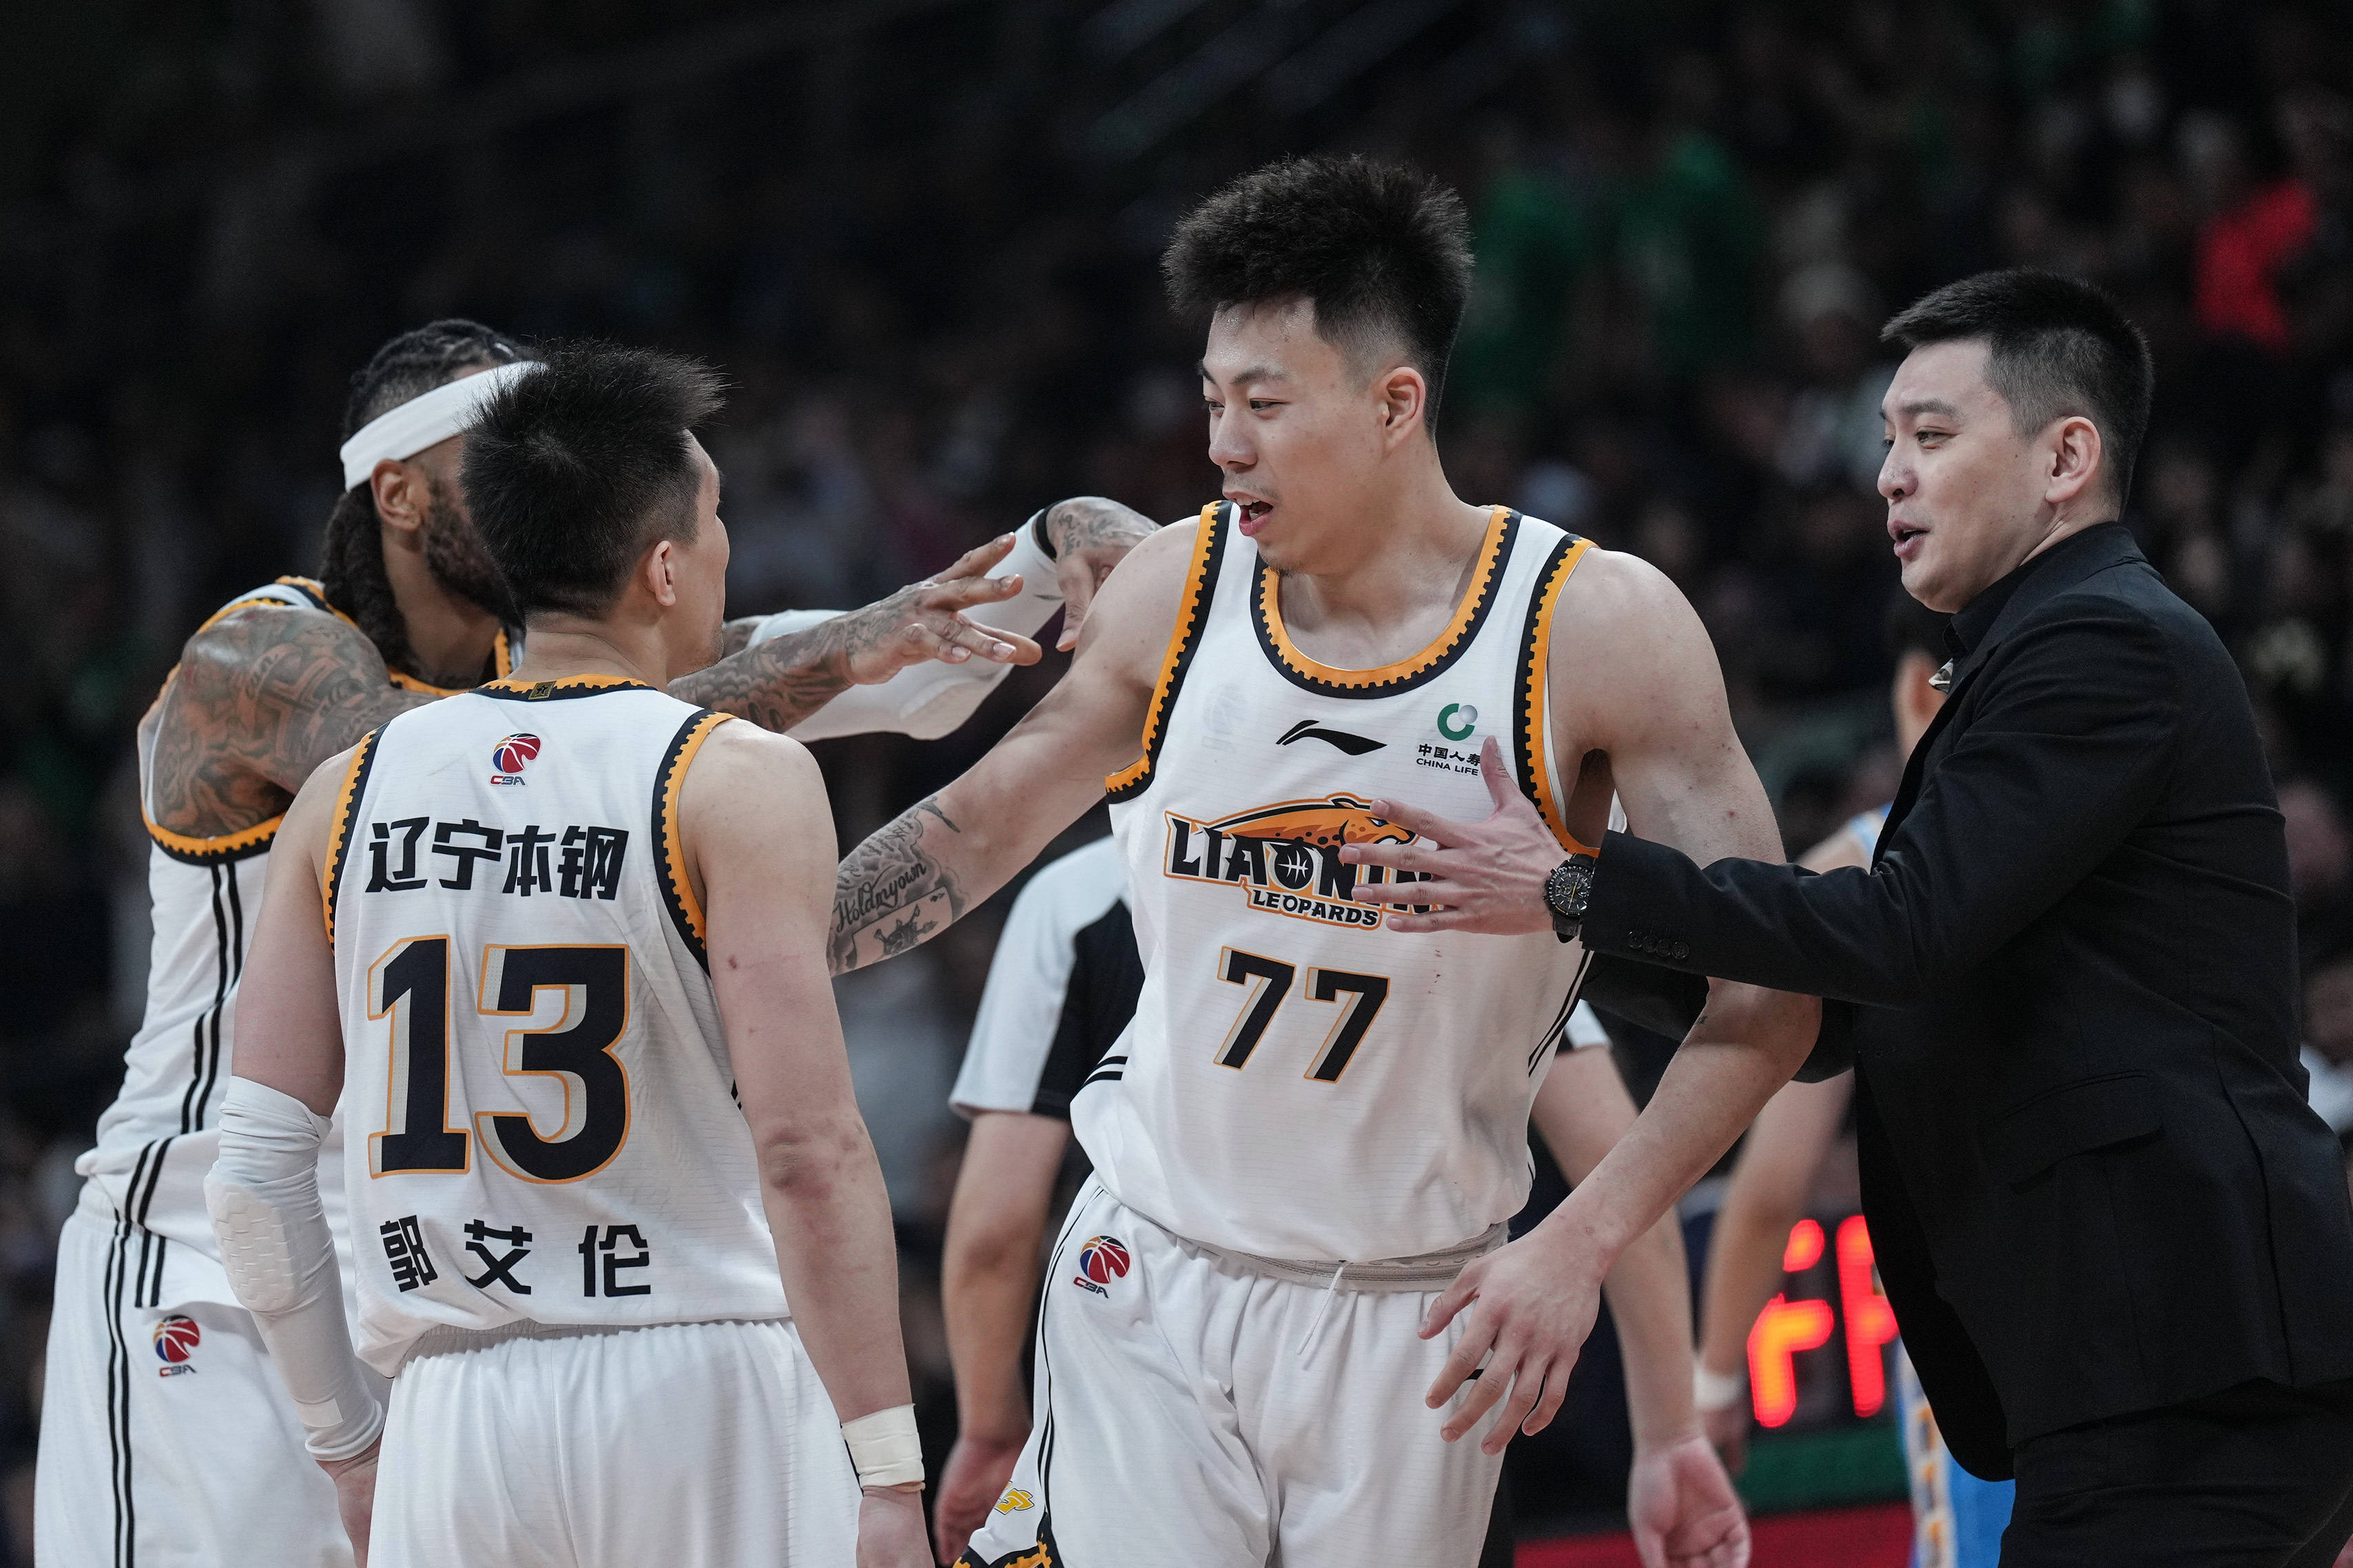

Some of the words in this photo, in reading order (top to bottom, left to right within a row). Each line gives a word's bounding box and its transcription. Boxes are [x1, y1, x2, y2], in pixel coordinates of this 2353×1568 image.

[1416, 757, 1451, 771] CHINA
[1454, 765, 1479, 776] LIFE
[1418, 743, 1481, 766] 中国人寿
[490, 775, 526, 786] CBA
[364, 816, 630, 901] 辽宁本钢
[1168, 815, 1442, 914] LIAON
[1252, 888, 1378, 926] LEOPARDS
[1213, 945, 1391, 1083] 77
[367, 934, 631, 1184] 13
[380, 1214, 652, 1297] 郭艾伦
[1073, 1276, 1109, 1299] CBA
[159, 1364, 197, 1377] CBA
